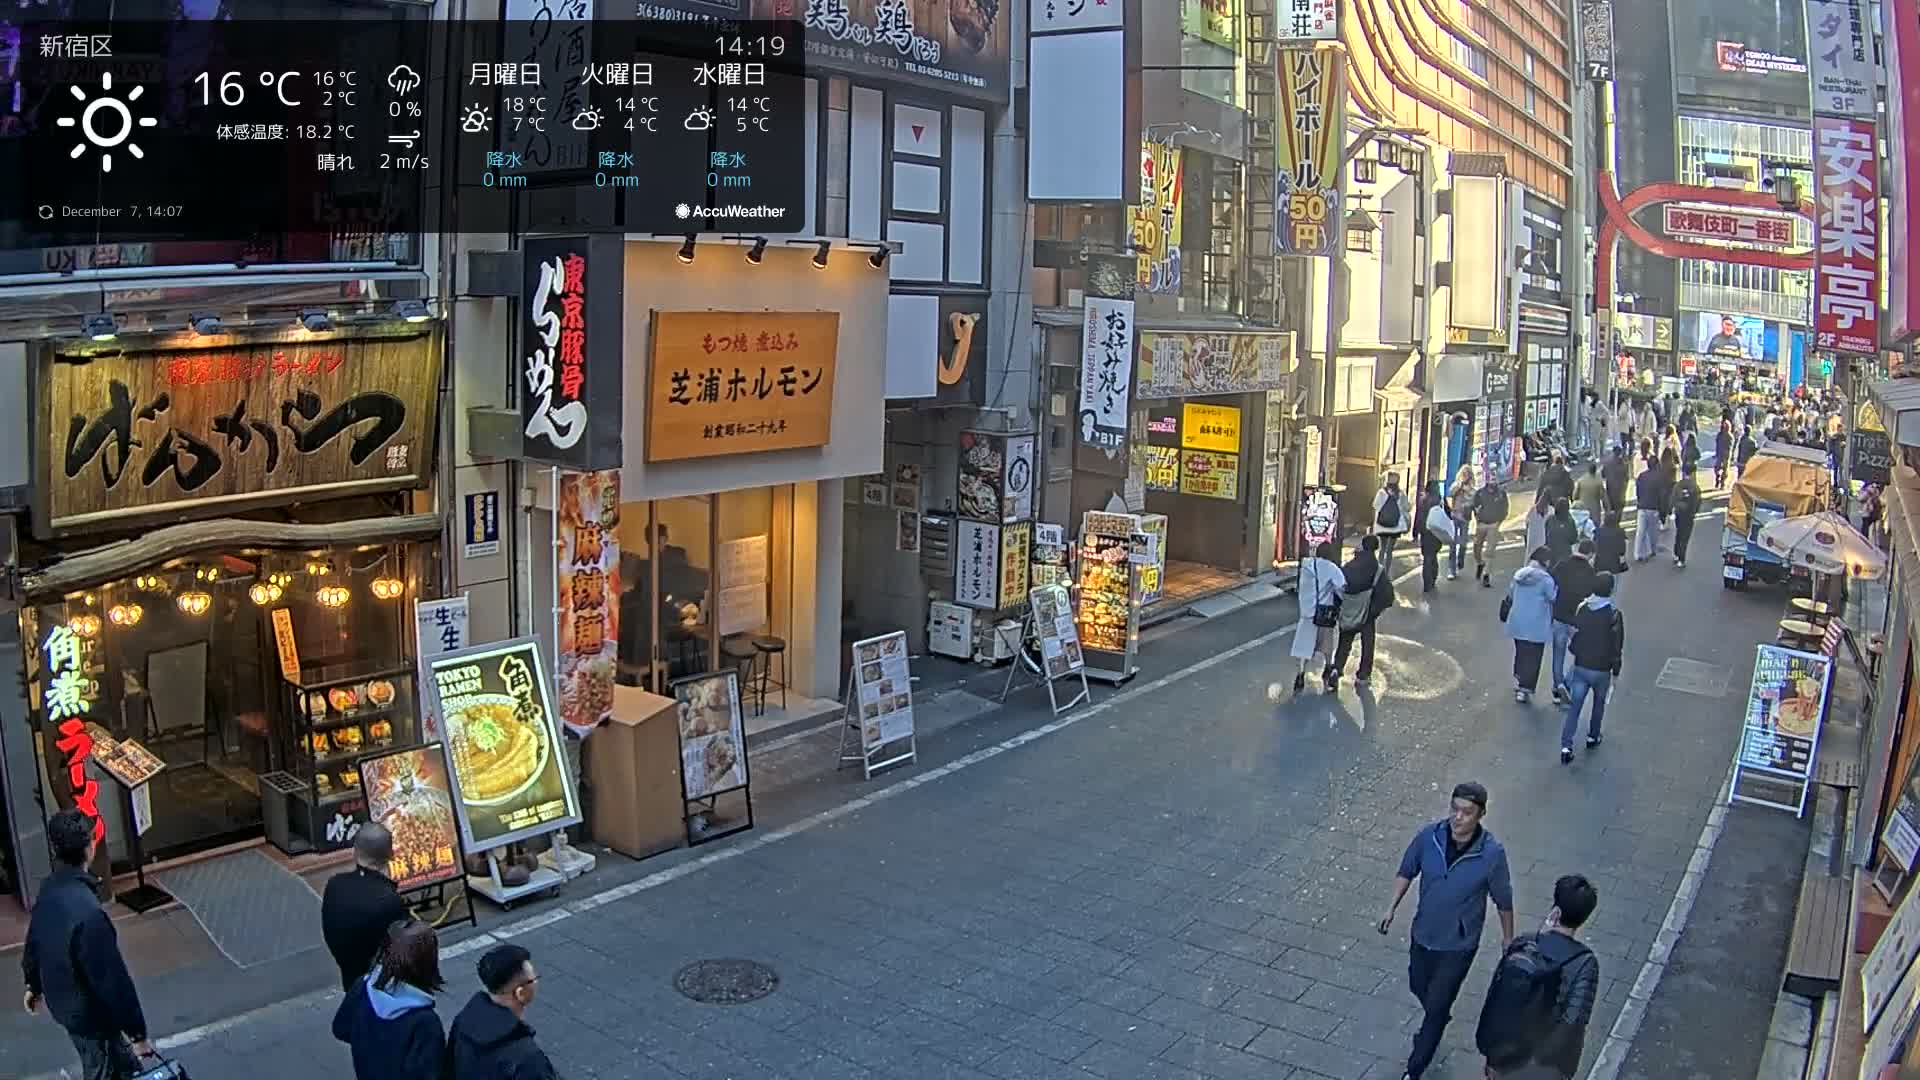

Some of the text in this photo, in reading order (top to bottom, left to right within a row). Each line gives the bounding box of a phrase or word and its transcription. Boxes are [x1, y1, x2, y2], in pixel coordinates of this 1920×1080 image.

[1589, 63, 1608, 78] 7F
[1832, 96, 1855, 110] 3F
[1296, 52, 1321, 190] ハイボール
[1670, 210, 1790, 240] 歌舞伎町一番街
[1818, 127, 1876, 331] 安楽亭
[561, 254, 585, 399] 東京豚骨
[702, 332, 799, 353] もつ焼 煮込み
[1818, 333, 1836, 346] 2F
[1099, 309, 1127, 414] お好み焼き
[668, 365, 823, 407] 芝浦ホルモン
[1040, 530, 1057, 543] 4階
[435, 665, 481, 684] TOKYO
[439, 679, 483, 698] RAMEN
[499, 656, 543, 723] 角煮
